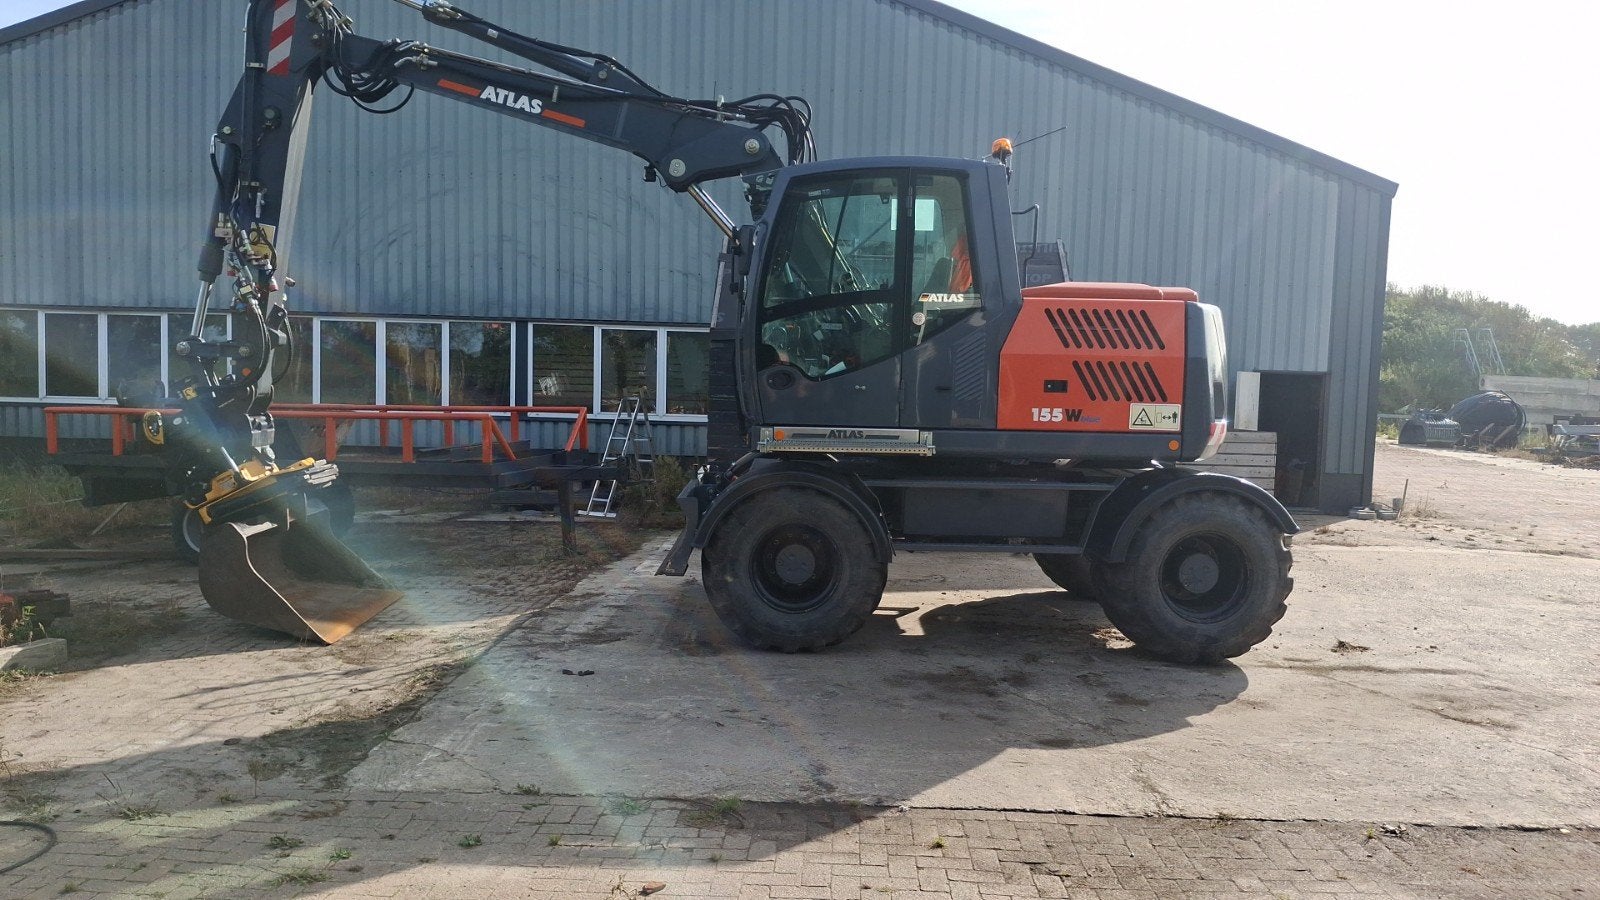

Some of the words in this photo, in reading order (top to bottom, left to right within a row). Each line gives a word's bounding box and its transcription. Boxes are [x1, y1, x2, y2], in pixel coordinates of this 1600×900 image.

[480, 85, 542, 114] ATLAS
[929, 293, 965, 303] ATLAS
[825, 429, 864, 439] ATLAS
